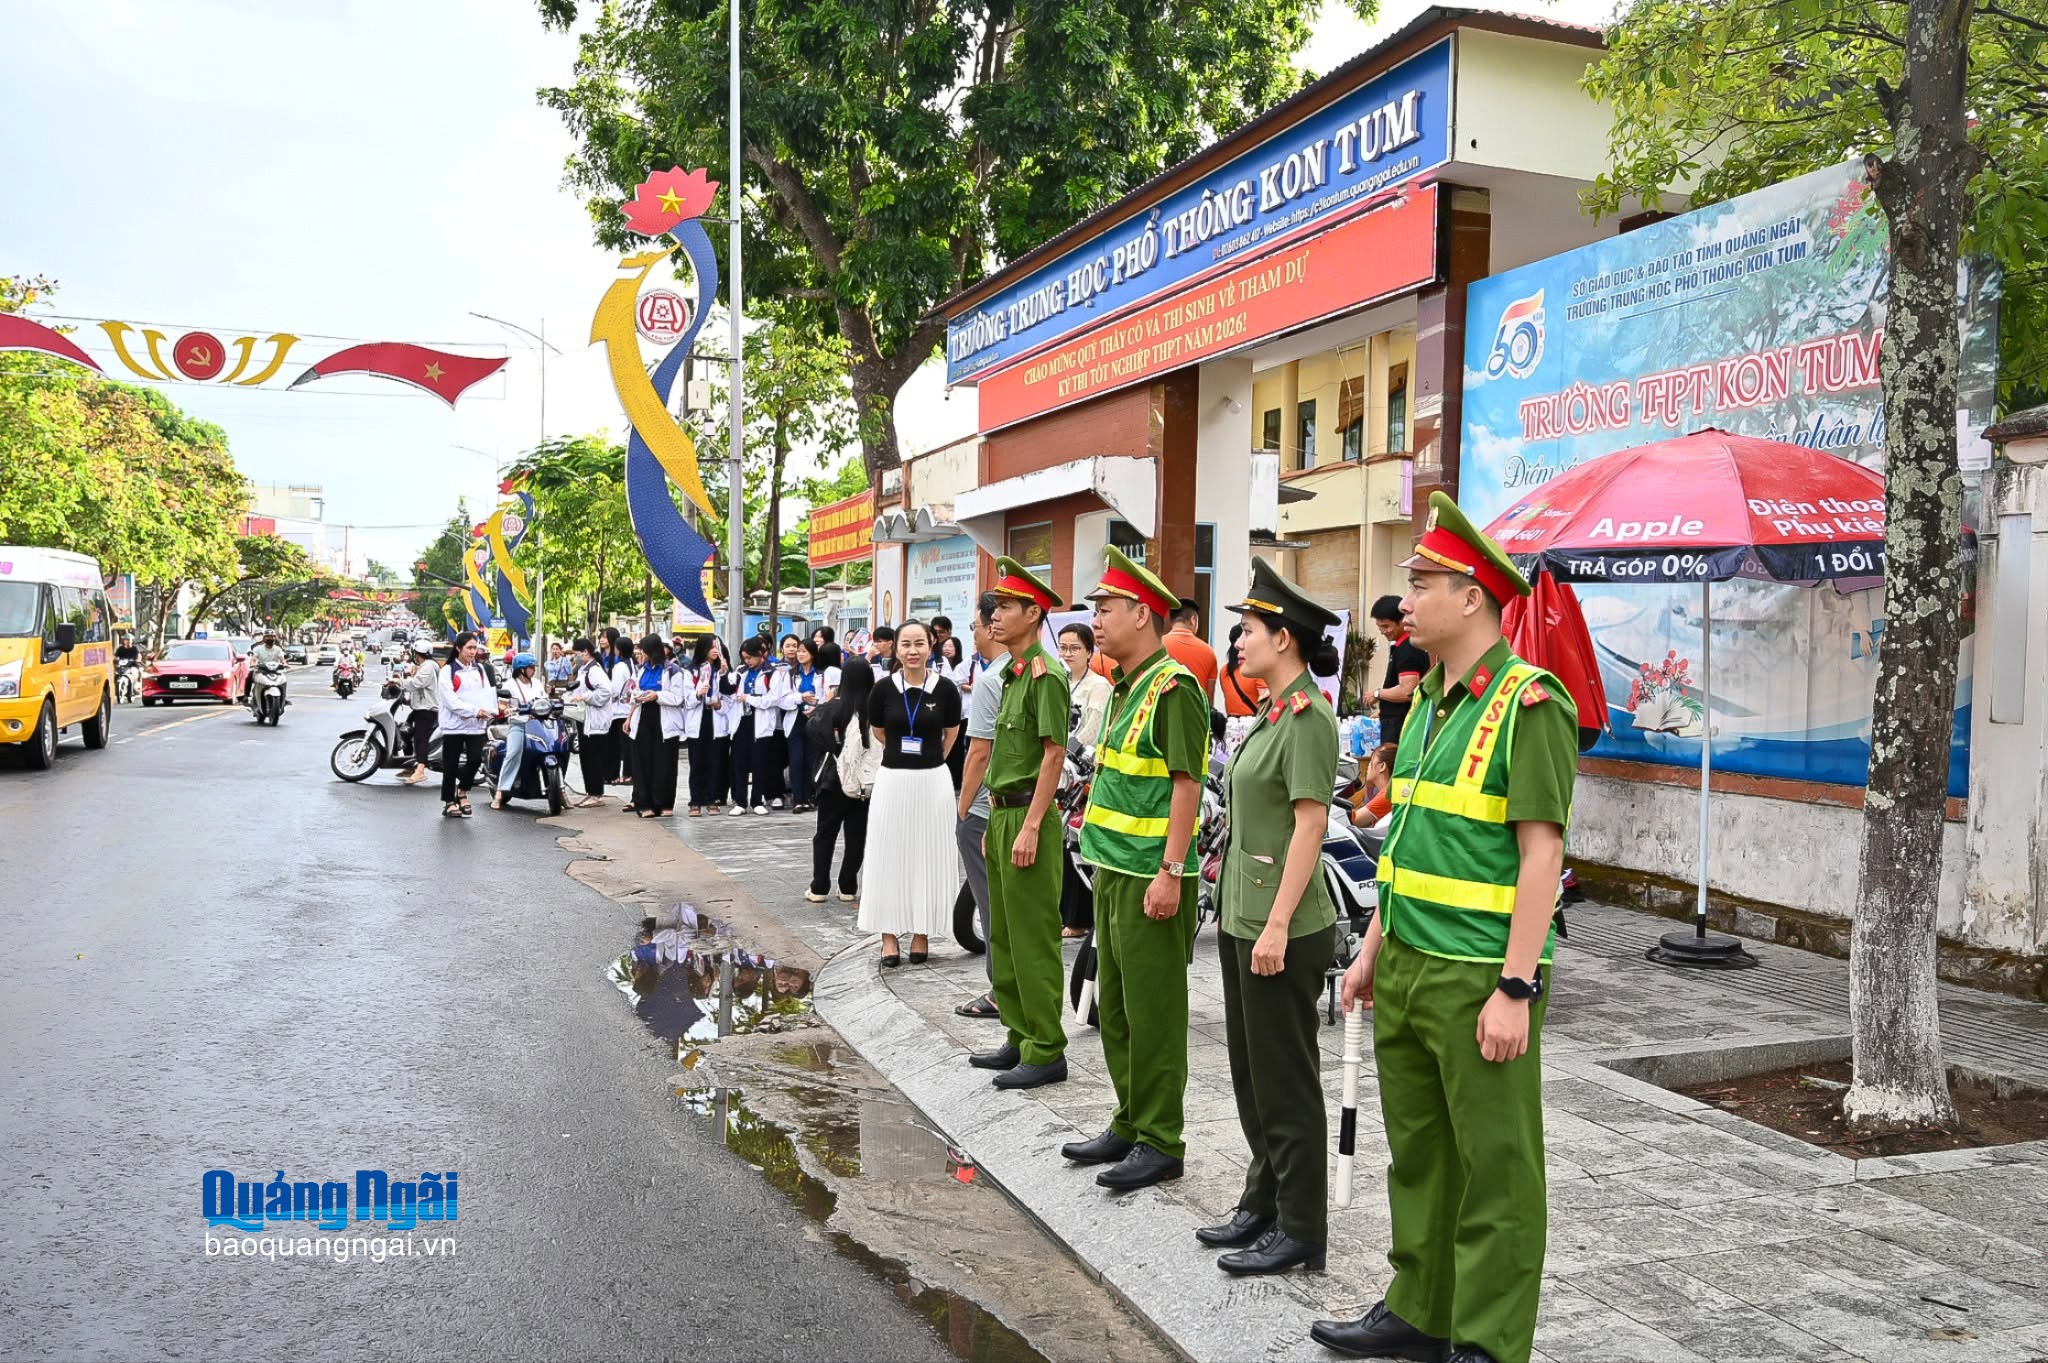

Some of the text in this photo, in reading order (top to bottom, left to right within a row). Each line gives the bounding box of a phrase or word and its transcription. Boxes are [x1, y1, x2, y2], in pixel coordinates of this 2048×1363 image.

[951, 88, 1420, 362] TRƯỜNG TRUNG HỌC PHỔ THÔNG KON TUM
[1588, 273, 1611, 293] GIÁO
[1613, 268, 1633, 287] DỤC
[1637, 266, 1645, 280] &
[1648, 257, 1669, 276] ĐÀO
[1673, 251, 1692, 271] TẠO
[1725, 228, 1766, 255] QUẢNG
[1770, 216, 1801, 241] NGÃI
[1127, 321, 1144, 345] CÔ
[1185, 293, 1215, 323] SINH
[1239, 265, 1281, 302] THAM
[1285, 249, 1310, 284] DỰ
[1610, 288, 1645, 310] TRUNG
[1648, 280, 1671, 301] HỌC
[1674, 265, 1699, 293] PHỔ
[1702, 260, 1743, 285] THÔNG
[1746, 251, 1773, 273] KON
[1777, 241, 1807, 264] TUM
[1072, 370, 1088, 394] THI
[1111, 348, 1151, 379] NGHIỆP
[1152, 336, 1182, 364] THPT
[1184, 325, 1213, 353] NĂM
[1216, 312, 1247, 342] 2026!
[1520, 330, 1883, 440] TRƯỜNG THPT KON TUM
[1795, 413, 1862, 449] nhân
[1588, 515, 1704, 541] Apple
[1747, 496, 1885, 519] Điện thoạ
[1772, 516, 1884, 540] Phụ kiệ
[1568, 554, 1709, 577] TRẢ GÓP 0%
[1815, 554, 1826, 572] 1
[1832, 546, 1873, 572] ĐỔI
[1128, 672, 1165, 744] CSTT
[1467, 675, 1519, 778] CSTT
